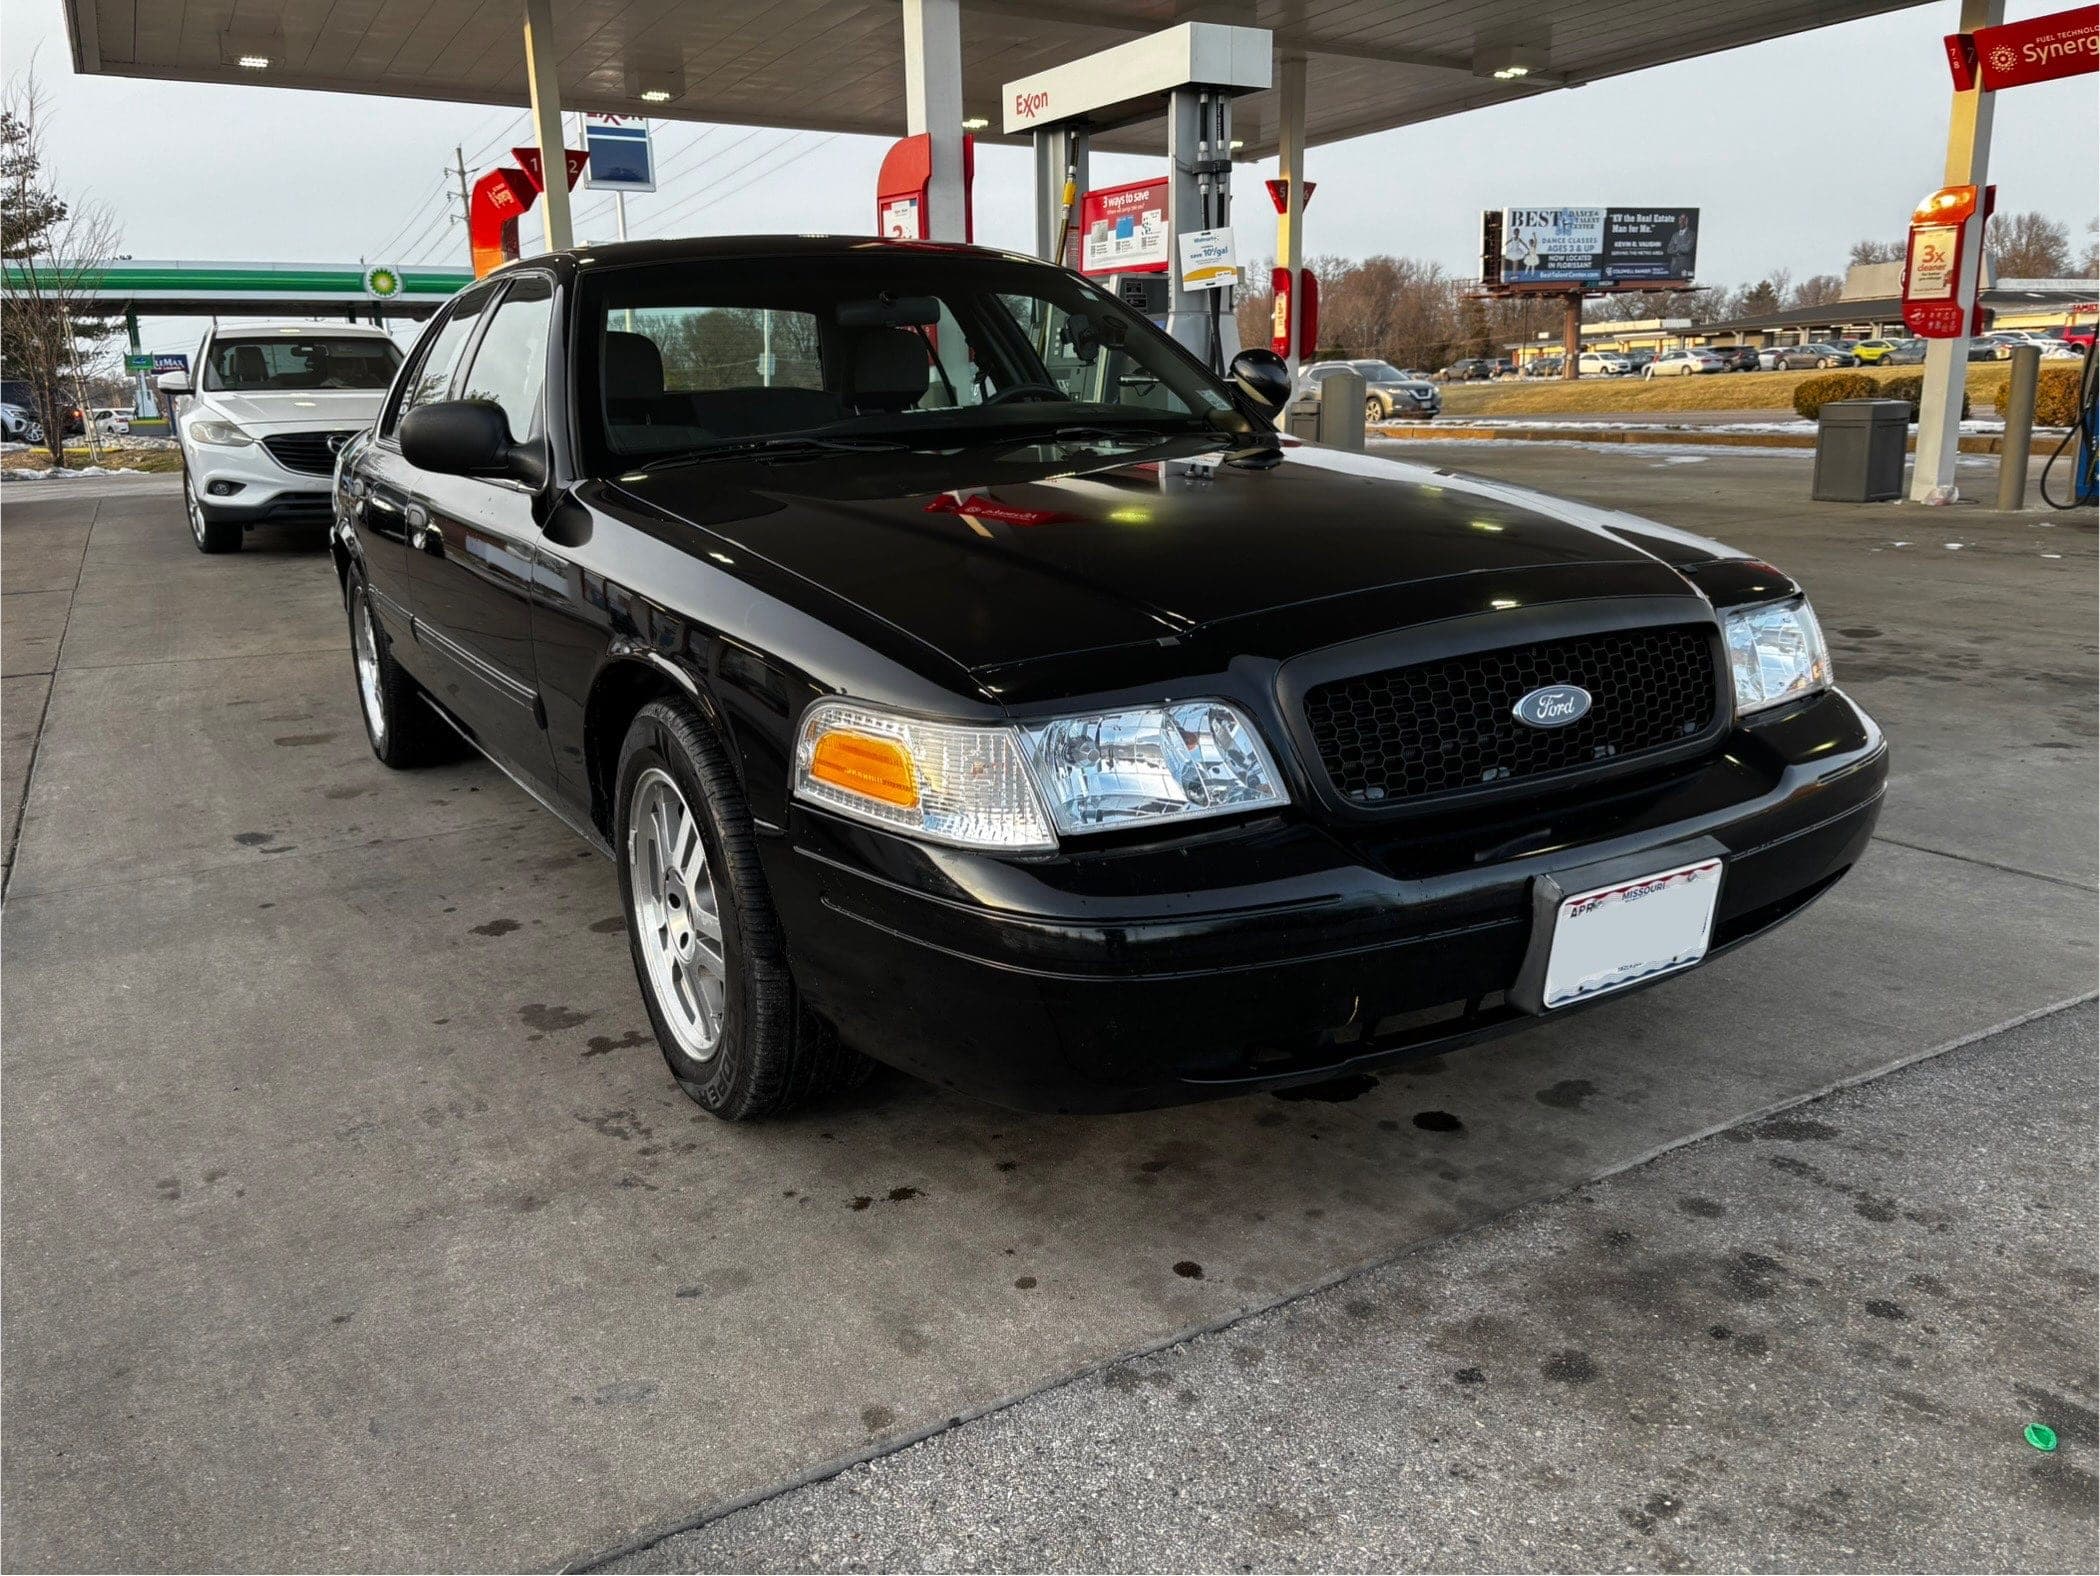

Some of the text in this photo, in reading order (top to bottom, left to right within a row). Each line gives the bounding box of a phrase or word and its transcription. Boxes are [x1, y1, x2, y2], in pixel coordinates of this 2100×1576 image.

[2036, 34, 2055, 44] FUEL
[1016, 92, 1048, 118] Exxon
[530, 157, 538, 171] 1
[568, 159, 579, 174] 2
[1102, 195, 1108, 208] 3
[1108, 195, 1125, 209] ways
[1125, 192, 1133, 204] to
[1133, 190, 1149, 203] save
[1279, 187, 1286, 198] 5
[1511, 210, 1561, 228] BEST
[1623, 213, 1635, 223] the
[1636, 213, 1652, 223] Real
[1653, 213, 1676, 223] Estate
[1611, 224, 1627, 233] Man
[1628, 224, 1639, 233] for
[1548, 244, 1567, 252] AGES
[1583, 244, 1595, 252] UP
[1922, 244, 1946, 263] 3x
[1548, 254, 1592, 262] NOW LOCATED
[1917, 264, 1947, 272] cleaner
[1537, 693, 1575, 719] Ford
[1621, 882, 1666, 901] MISSOURI
[1570, 902, 1593, 918] APR
